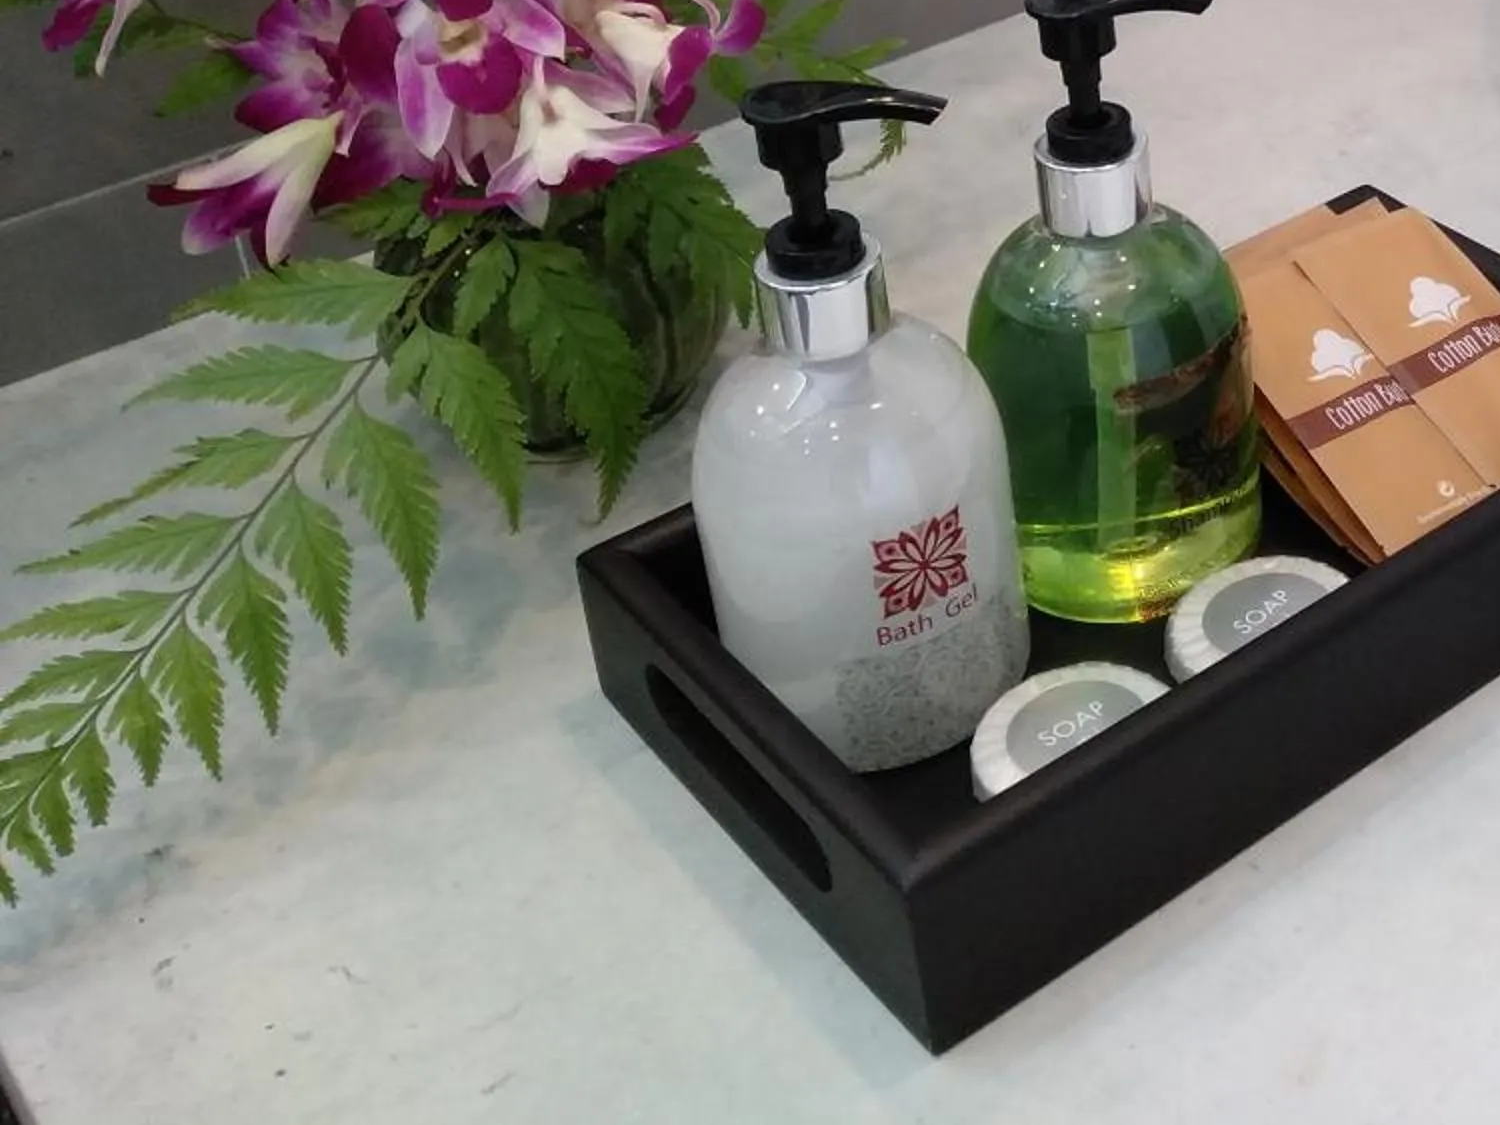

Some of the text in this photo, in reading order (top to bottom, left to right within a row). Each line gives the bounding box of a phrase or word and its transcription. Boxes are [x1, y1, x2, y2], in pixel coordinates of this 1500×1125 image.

[1426, 333, 1482, 373] Cotton
[1325, 390, 1381, 430] Cotton
[876, 582, 978, 647] Bath Gel
[1232, 589, 1290, 635] SOAP
[1037, 699, 1104, 747] SOAP
